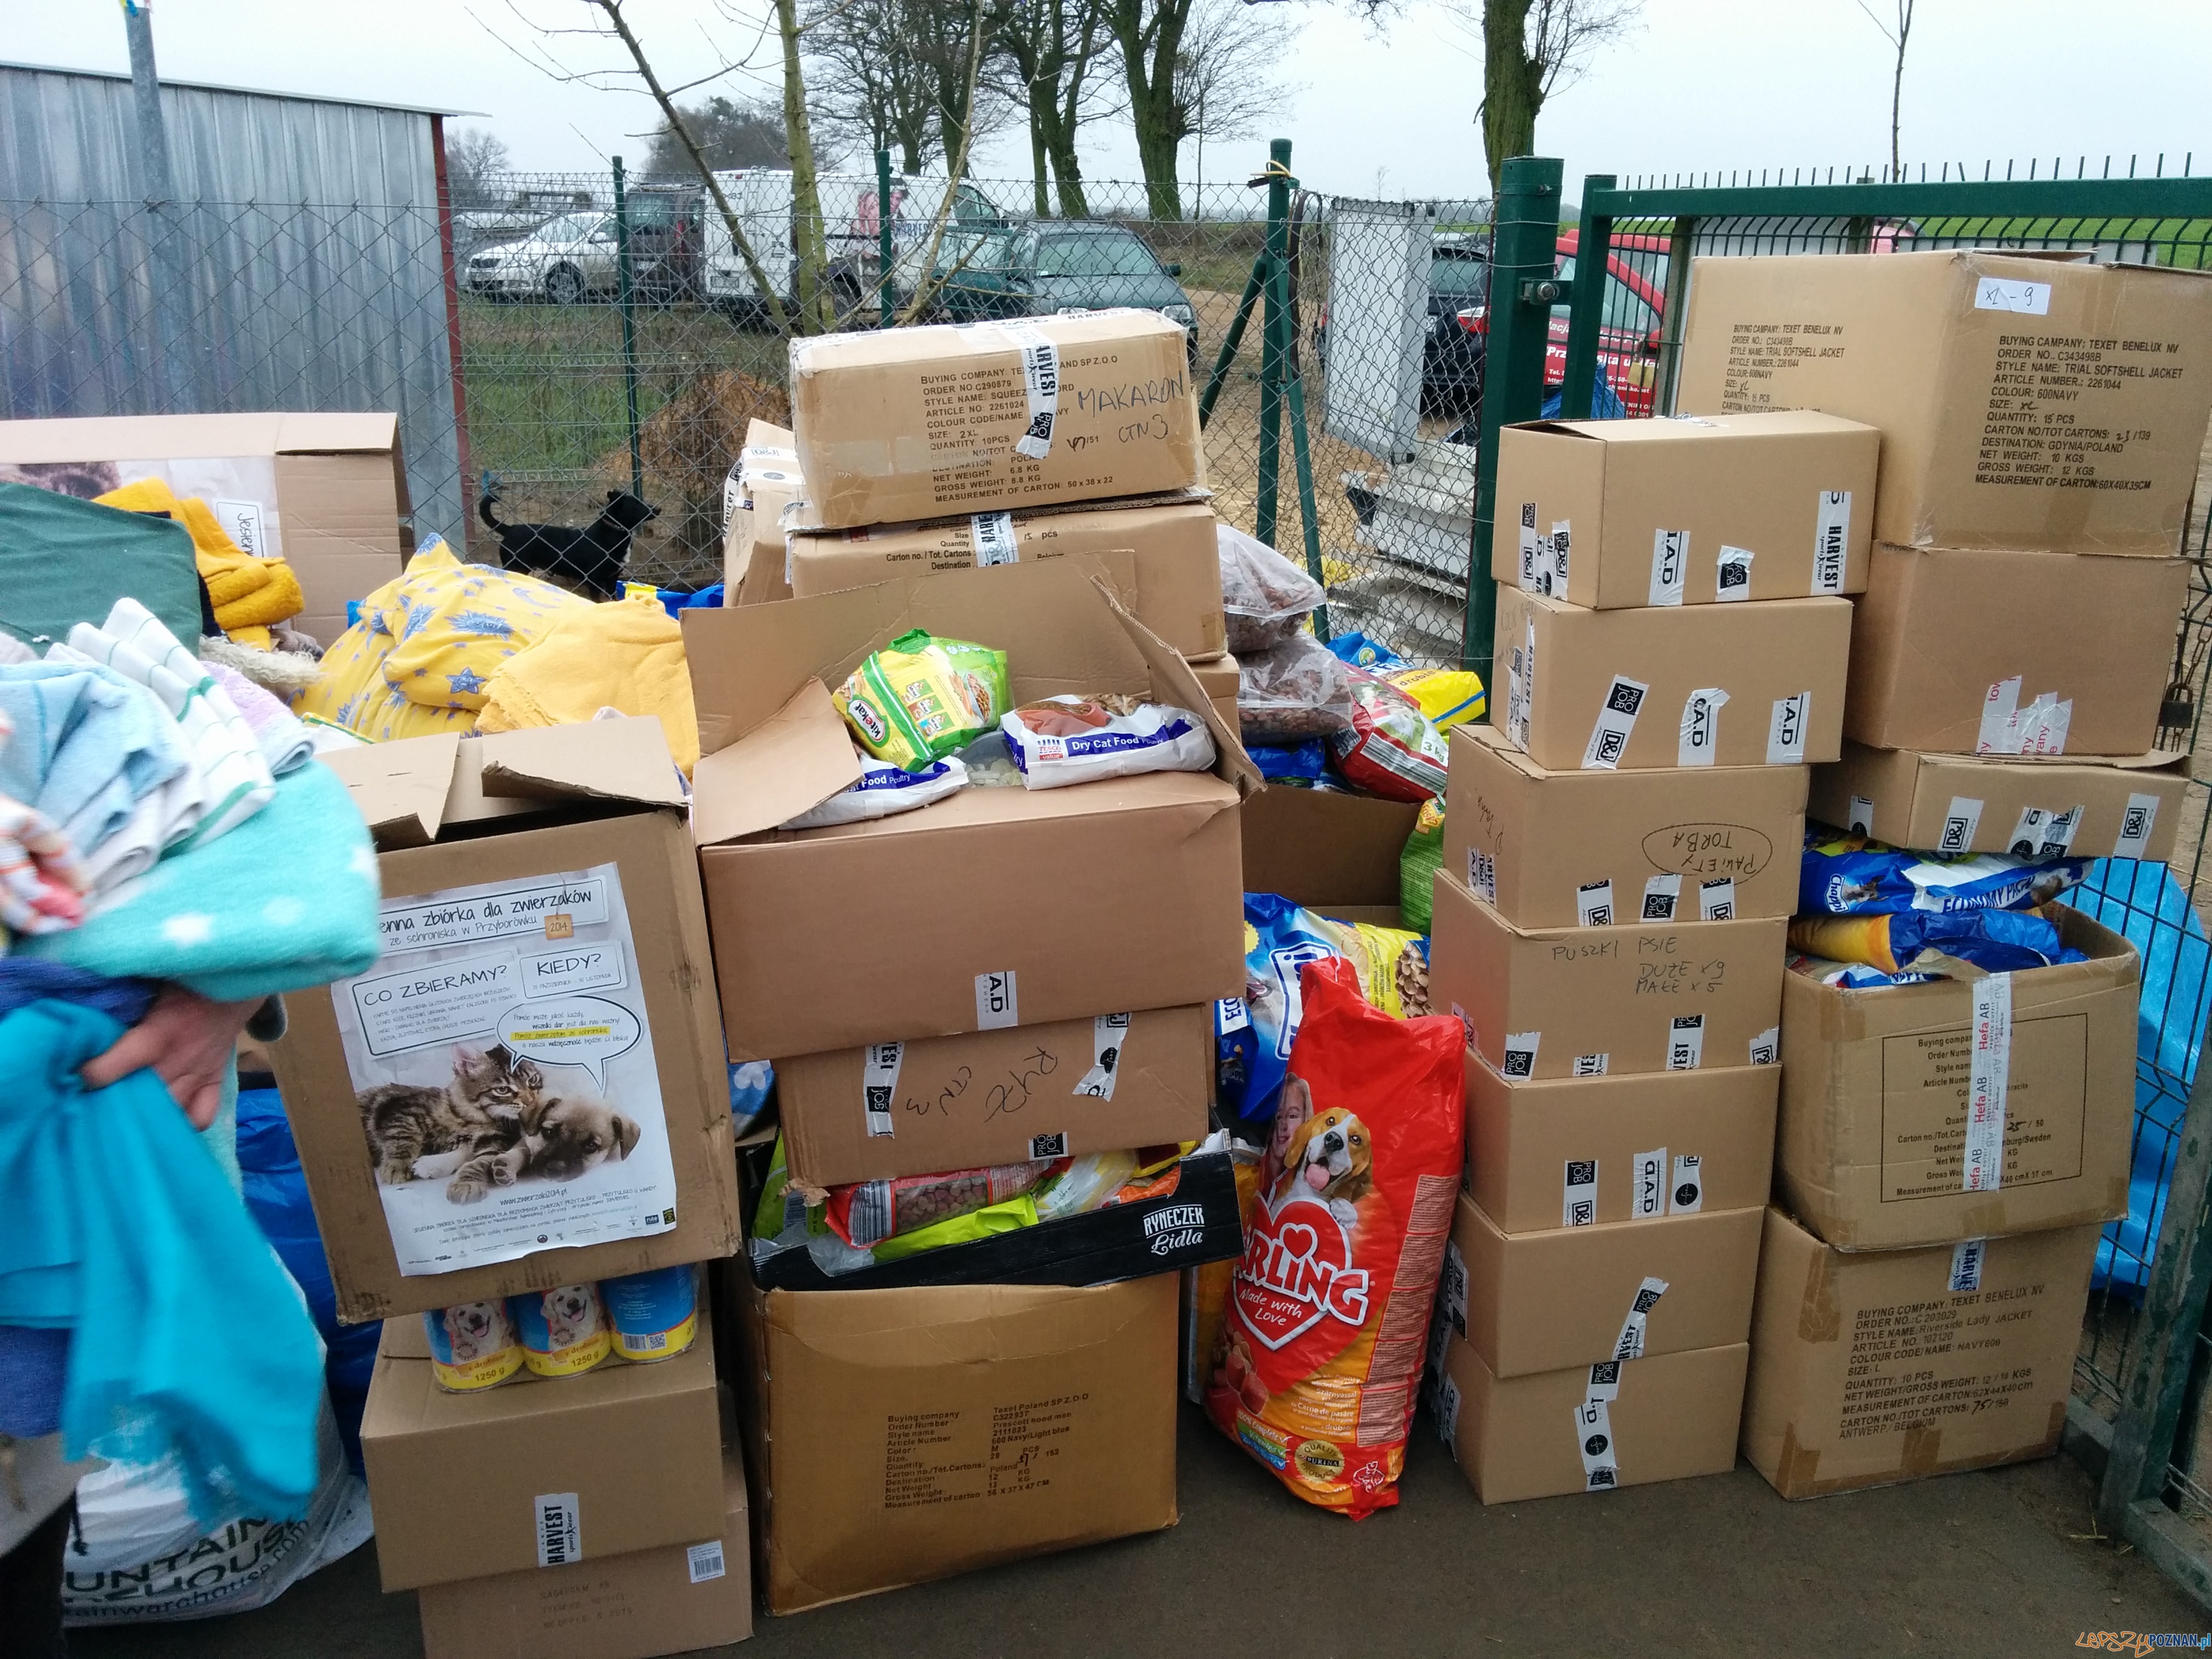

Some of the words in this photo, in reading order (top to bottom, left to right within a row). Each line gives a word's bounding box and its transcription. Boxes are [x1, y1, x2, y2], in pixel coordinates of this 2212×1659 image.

[1734, 325, 1752, 333] BUYING
[1782, 325, 1801, 333] TEXET
[1803, 325, 1831, 335] BENELUX
[1999, 335, 2034, 346] BUYING
[2089, 340, 2118, 350] TEXET
[2122, 341, 2162, 352] BENELUX
[2166, 344, 2179, 353] NV
[1730, 346, 1746, 355] STYLE
[1766, 348, 1781, 356] TRIAL
[1783, 347, 1817, 357] SOFTSHELL
[1819, 348, 1845, 358] JACKET
[1998, 349, 2031, 359] ORDER
[2057, 352, 2102, 362] C343498B
[920, 374, 957, 385] BUYING
[961, 369, 1006, 381] COMPANY
[1995, 361, 2026, 371] STYLE
[2064, 363, 2091, 374] TRIAL
[2094, 365, 2146, 377] SOFTSHELL
[2148, 368, 2184, 380] JACKET
[1993, 374, 2034, 385] ARTICLE
[2087, 378, 2121, 390] 2261044
[923, 385, 955, 395] ORDER
[1078, 371, 1184, 418] MAKARON
[1991, 386, 2034, 398] COLOUR:
[2036, 388, 2079, 402] 600NAVY
[924, 395, 953, 407] STYLE
[926, 406, 965, 417] ARTICLE
[989, 400, 1025, 411] 2261024
[1989, 399, 2013, 409] SIZE:
[927, 417, 966, 428] COLOUR
[1986, 412, 2037, 424] QUANTITY:
[2055, 414, 2075, 424] PCS
[1151, 413, 1168, 440] 3
[1984, 424, 2024, 436] CARTON
[2064, 428, 2110, 439] CARTONS:
[1982, 438, 2045, 449] DESTINATION:
[2048, 441, 2124, 453] GDYNIA/POLAND
[1980, 450, 1998, 459] NET
[2003, 451, 2042, 462] WEIGHT:
[2051, 453, 2060, 463] 10
[2064, 453, 2085, 464] KGS
[933, 474, 951, 483] NET
[1010, 466, 1023, 475] 6.8
[1026, 464, 1040, 473] KG
[1978, 462, 2011, 473] GROSS
[2015, 464, 2054, 474] WEIGHT:
[2062, 465, 2071, 475] 12
[2075, 466, 2095, 476] KGS
[934, 483, 966, 493] GROSS
[1011, 476, 1024, 485] 8.8
[1028, 474, 1042, 483] KG
[1975, 474, 2044, 487] MEASUREMENT
[2045, 476, 2058, 487] OF
[935, 489, 1004, 503] MEASUREMENT
[1007, 487, 1020, 495] OF
[1067, 479, 1078, 489] 50
[1085, 478, 1096, 487] 38
[1103, 476, 1113, 485] 22
[1041, 531, 1059, 541] pcs
[886, 552, 911, 562] Carton
[1824, 525, 1842, 590] HARVEST
[931, 560, 971, 570] Destination
[853, 701, 882, 739] kitekat
[1072, 741, 1090, 751] Dry
[1093, 739, 1111, 749] Cat
[1113, 737, 1139, 746] Food
[1424, 741, 1432, 752] 3
[1435, 746, 1445, 763] kg
[861, 774, 887, 788] Food
[888, 773, 911, 785] Poultry
[1829, 874, 1846, 913] Chappi
[422, 907, 476, 928] zbiórka
[484, 901, 503, 916] dla
[510, 889, 592, 914] zwierzaków
[388, 937, 402, 947] ze
[407, 927, 457, 945] schroniska
[462, 926, 470, 935] w
[475, 916, 538, 934] Przyborówku
[550, 922, 569, 933] 2014
[1552, 940, 1618, 961] PUSZKI
[1639, 937, 1677, 954] PSIE
[537, 953, 602, 977] KIEDY?
[364, 989, 392, 1006] CO
[399, 965, 508, 999] ZBIERAMY?
[1918, 1038, 1944, 1048] Buying
[1979, 1022, 1990, 1050] Hefa
[1928, 1052, 1948, 1060] Order
[1936, 1064, 1954, 1073] Style
[1923, 1078, 1948, 1088] Article
[1975, 1096, 1986, 1123] Hefa
[1897, 1183, 1945, 1196] Measurement
[1143, 1207, 1205, 1236] RYNECZEK
[1151, 1229, 1204, 1256] Lidla
[1240, 1288, 1266, 1305] Made
[1271, 1300, 1303, 1319] with
[1857, 1307, 1895, 1319] BUYING
[1897, 1300, 1948, 1315] COMPANY:
[1951, 1294, 1981, 1307] TEXET
[1985, 1288, 2028, 1304] BENELUX
[1255, 1307, 1287, 1326] Love
[1856, 1318, 1891, 1330] ORDER
[1853, 1330, 1885, 1341] STYLE
[1919, 1321, 1963, 1334] Riverside
[1967, 1314, 1990, 1327] Lady
[1994, 1310, 2033, 1323] JACKET
[1851, 1340, 1896, 1353] ARTICLE
[571, 1354, 593, 1368] 1250
[1850, 1351, 1891, 1364] COLOUR
[474, 1368, 497, 1382] 1250
[1845, 1376, 1898, 1390] QUANTITY:
[1914, 1370, 1933, 1382] PCS
[1019, 1400, 1049, 1412] Poland
[1842, 1397, 1916, 1415] MEASUREMENT
[888, 1414, 918, 1423] Buying
[920, 1411, 960, 1421] company
[1840, 1414, 1881, 1429] CARTON
[1922, 1403, 1969, 1417] CARTONS:
[1893, 1417, 1936, 1431] BELGIUM
[918, 1435, 951, 1444] Number
[886, 1462, 923, 1471] Quantity
[1307, 1457, 1339, 1467] PURINA
[954, 1492, 981, 1501] carton
[544, 1504, 566, 1564] HARVEST
